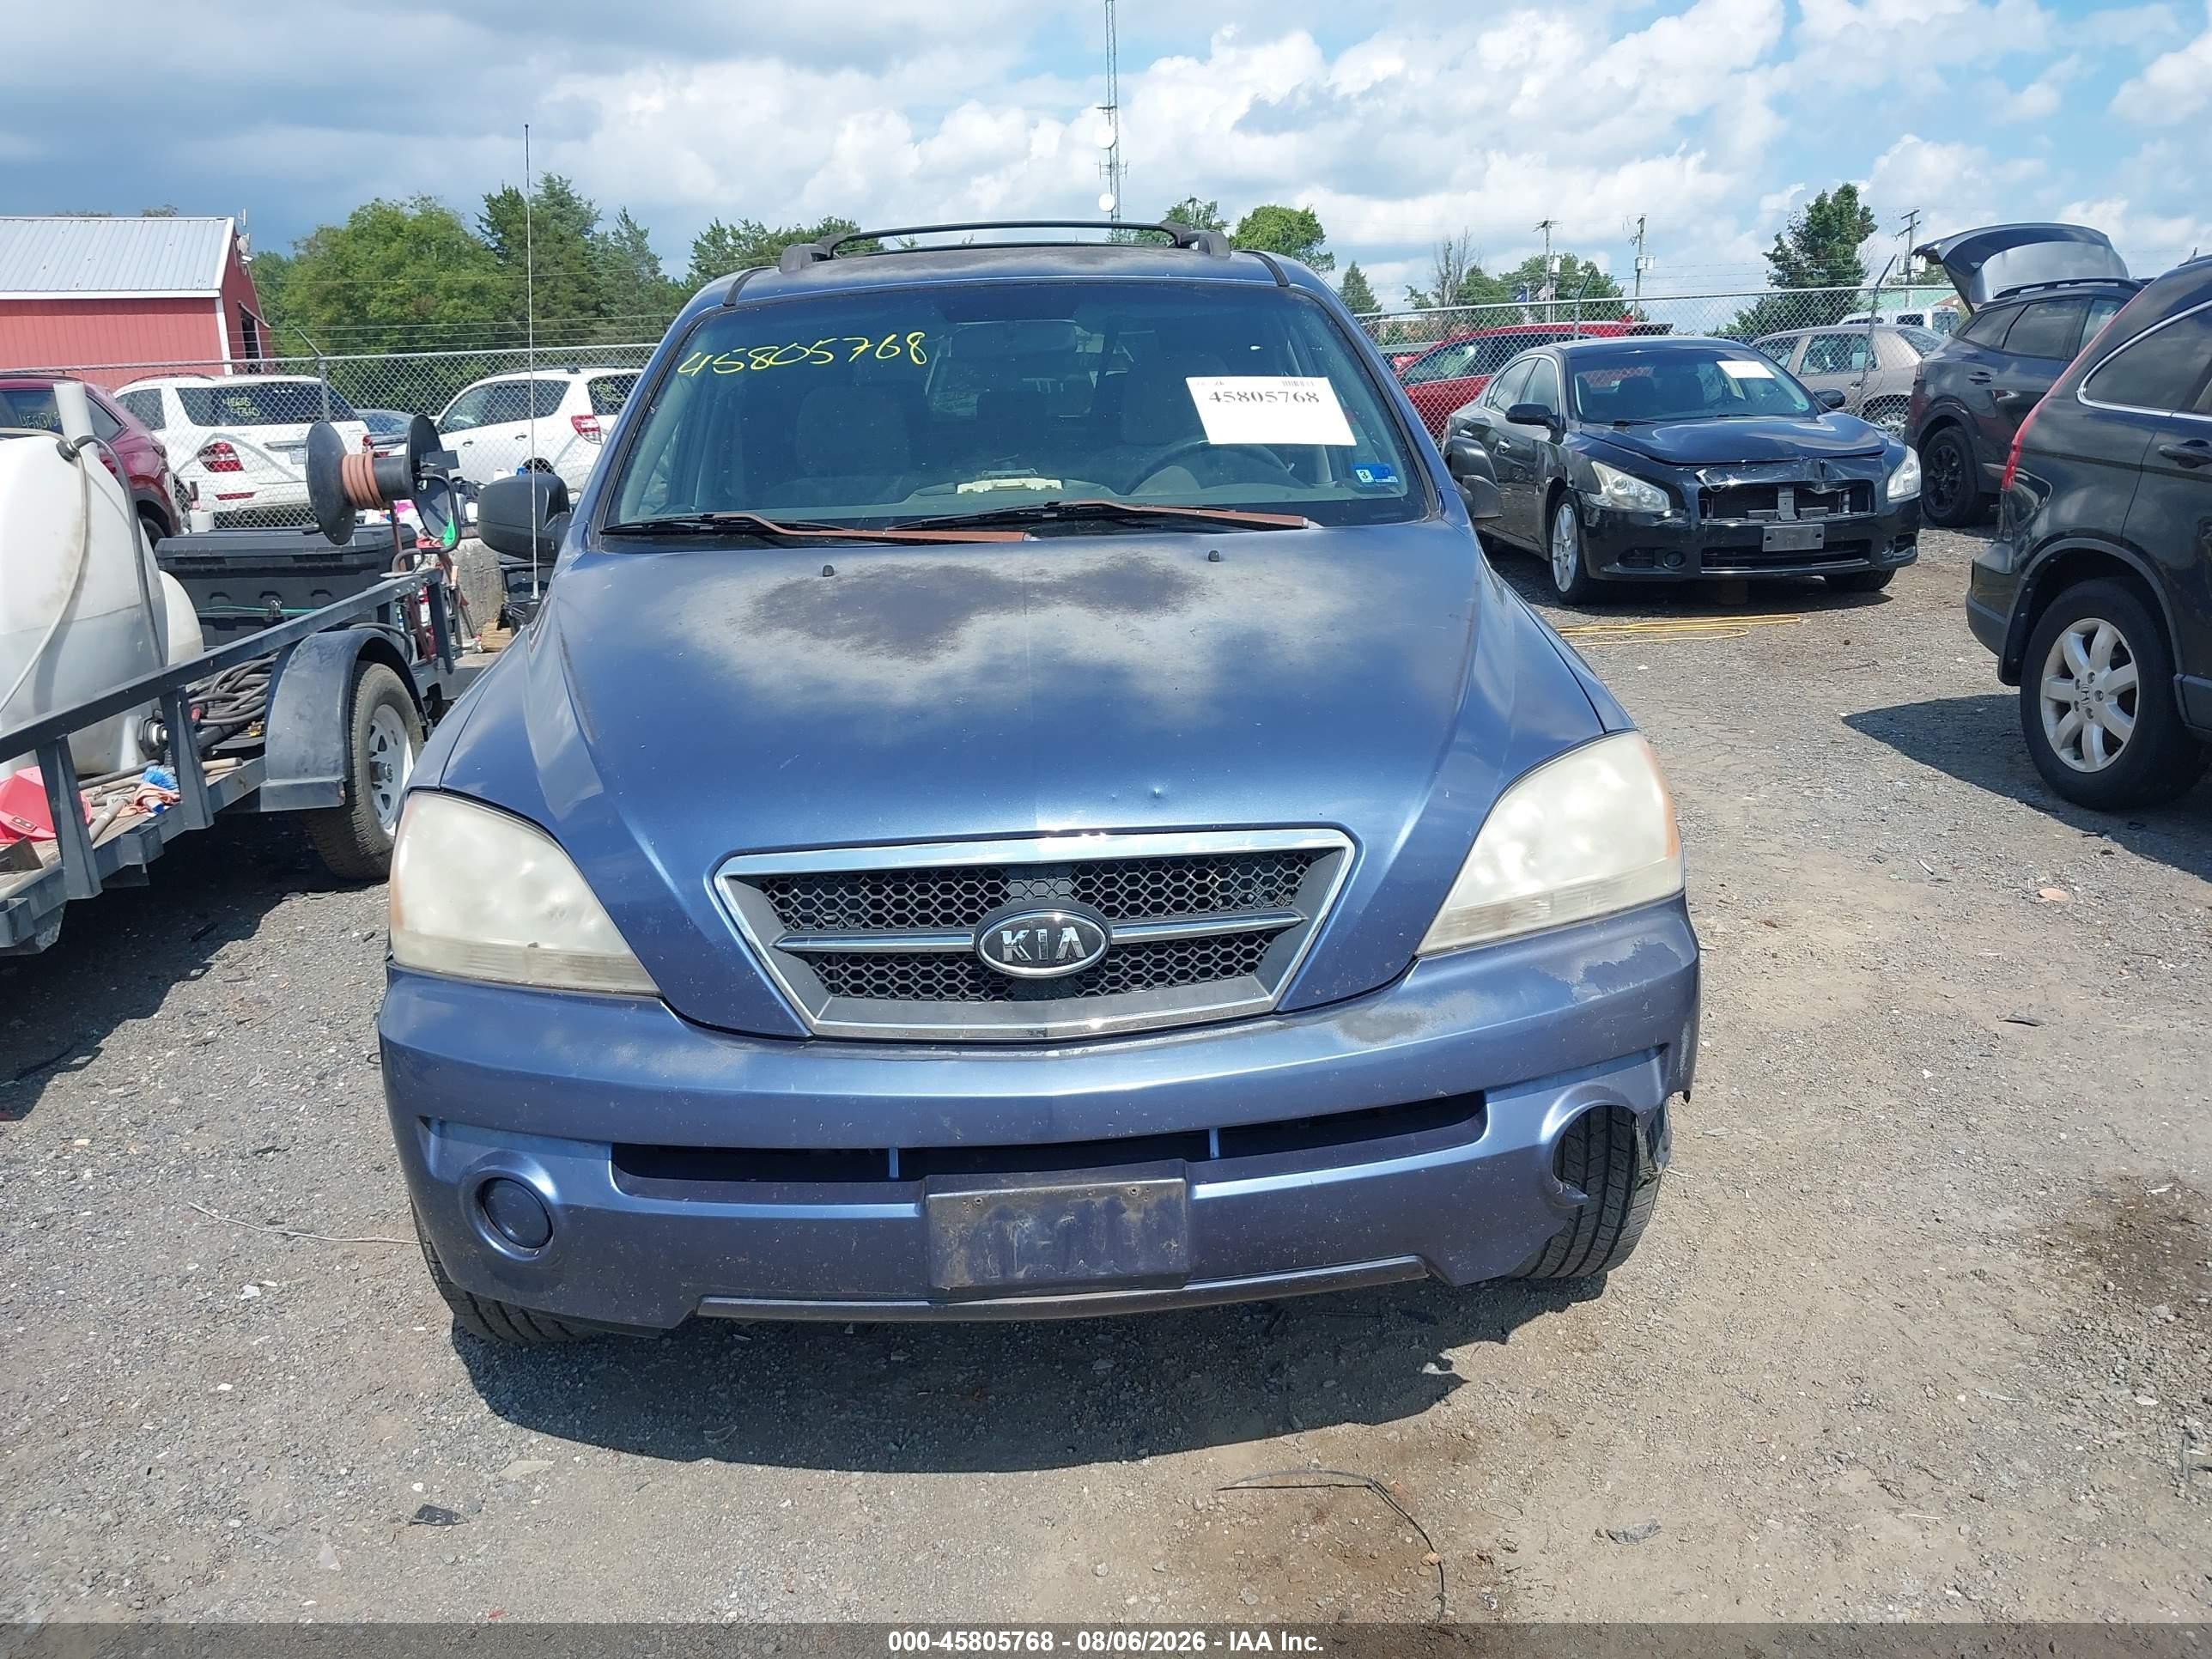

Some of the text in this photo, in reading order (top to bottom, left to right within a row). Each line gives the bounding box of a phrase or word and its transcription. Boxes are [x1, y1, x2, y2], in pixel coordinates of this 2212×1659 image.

[677, 331, 927, 376] 45805768
[1209, 391, 1320, 403] 45805768
[1000, 927, 1086, 962] KIA
